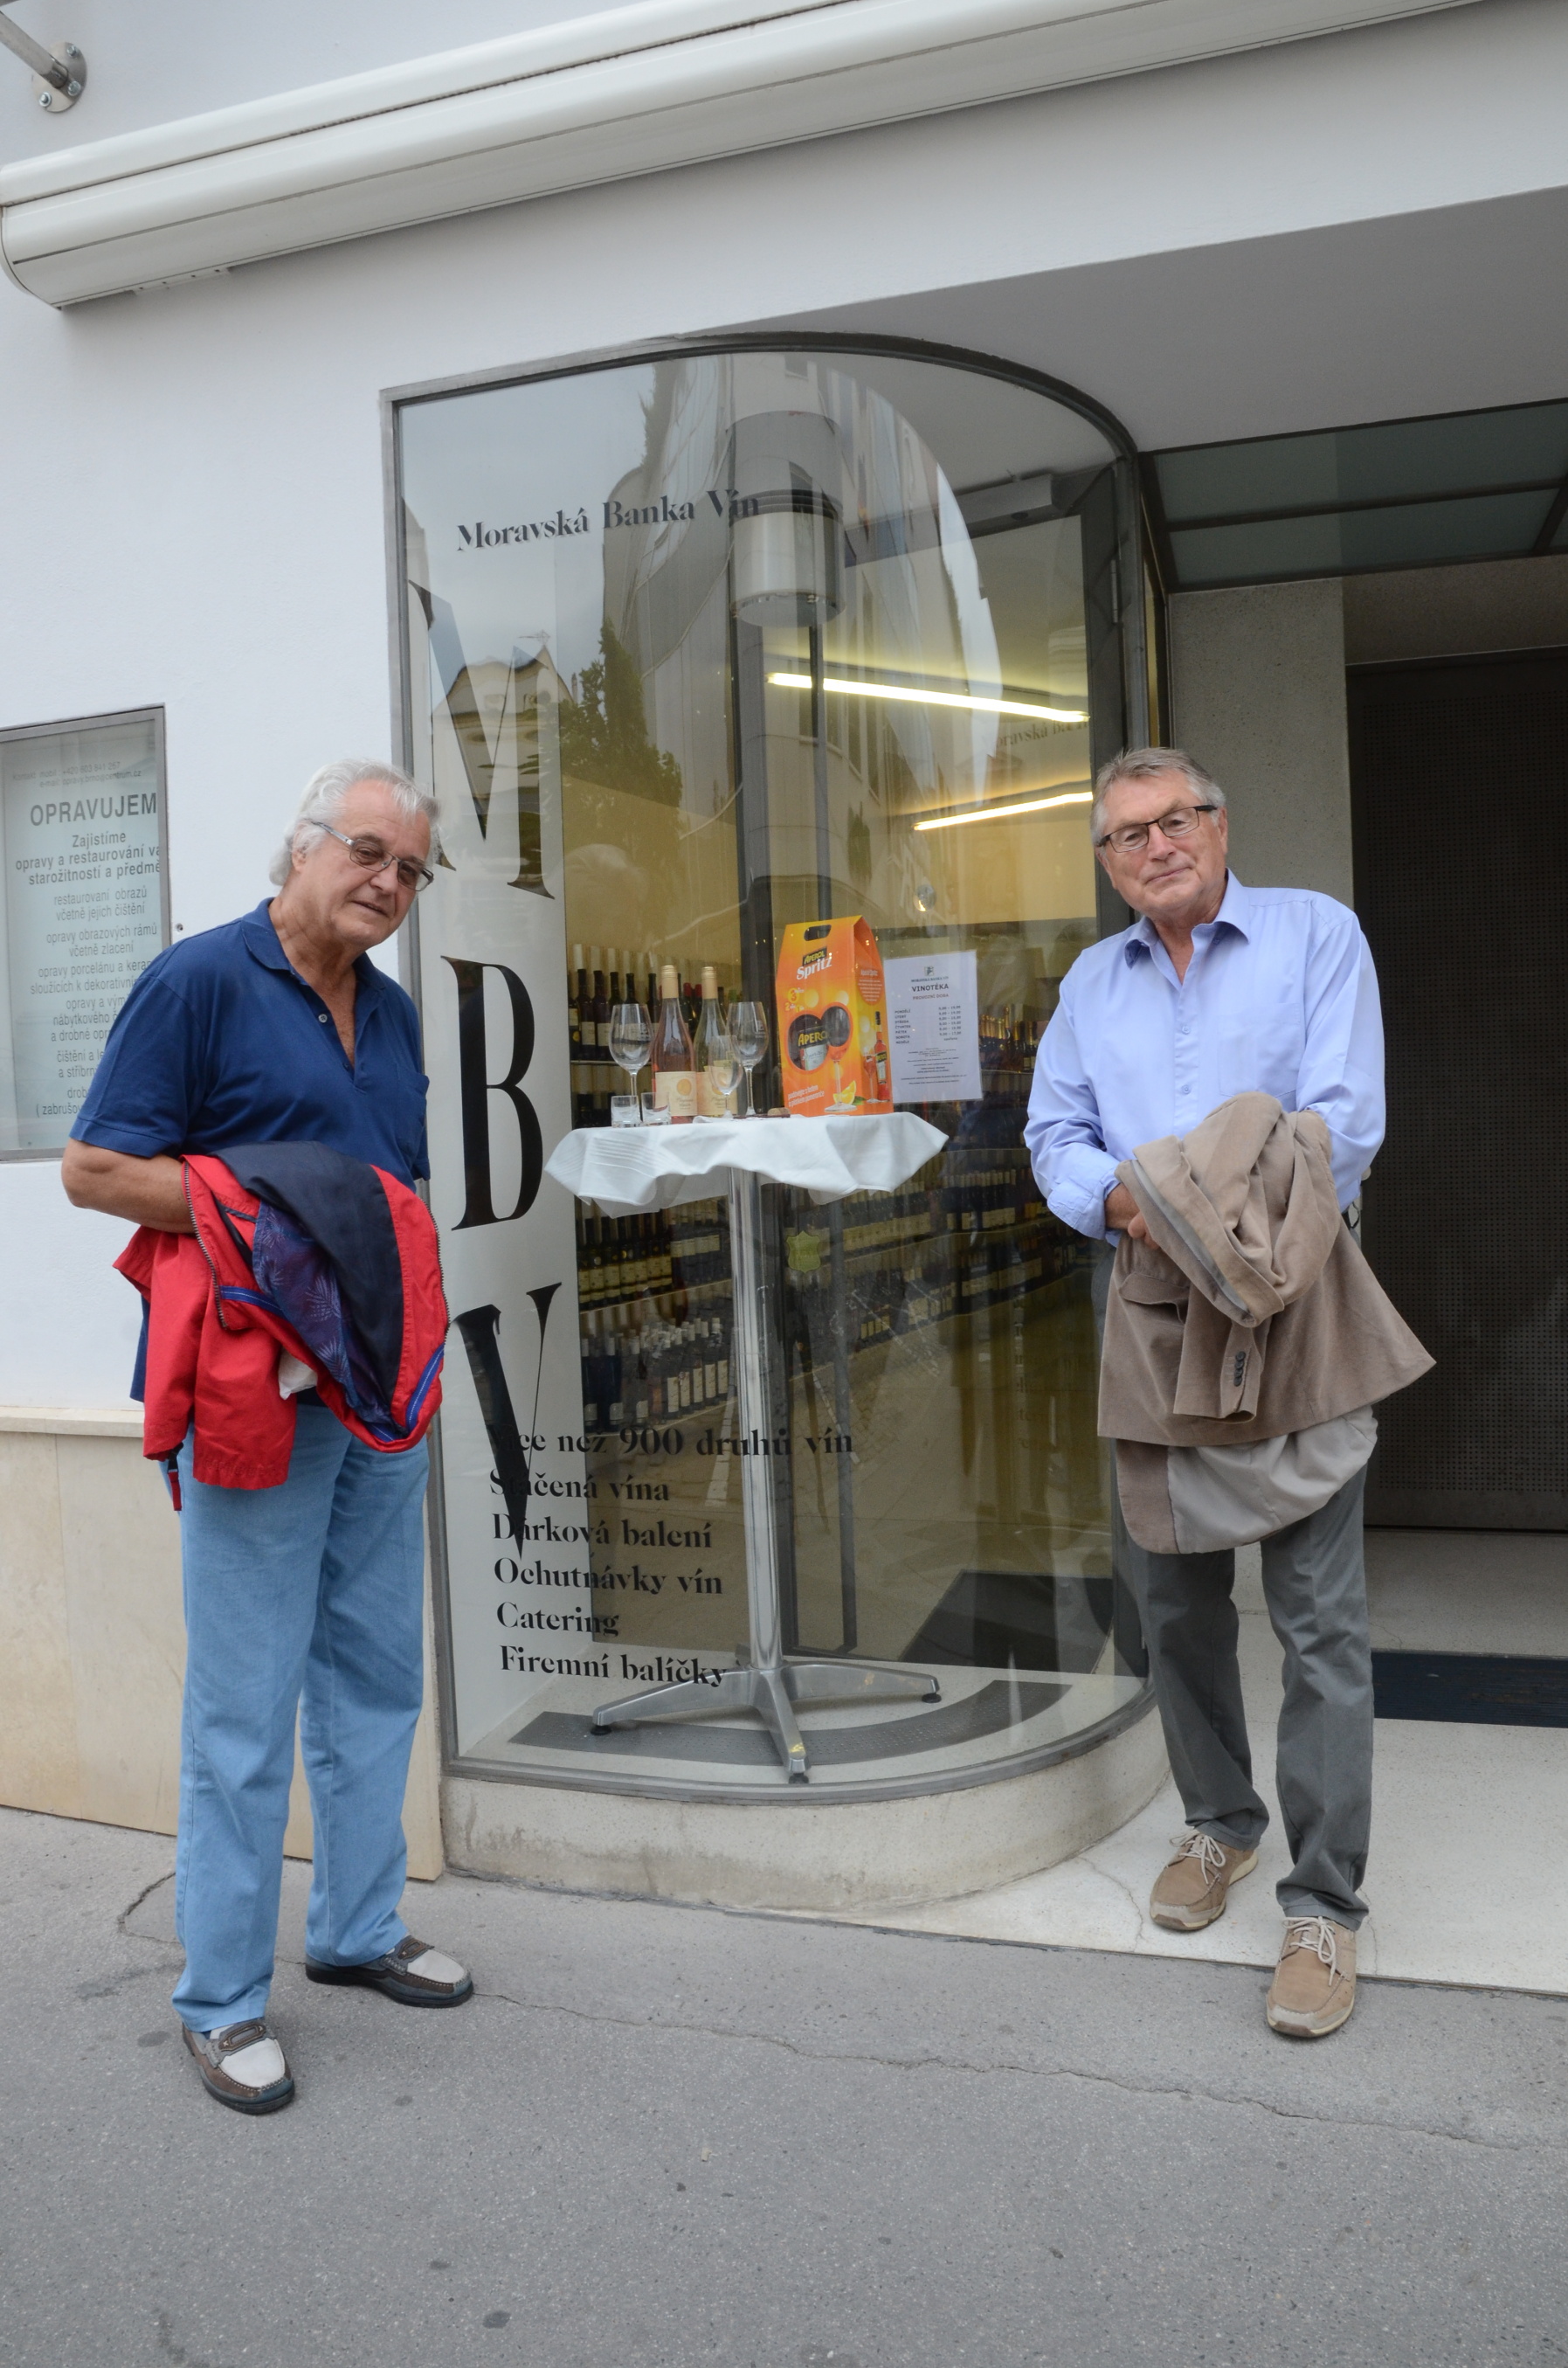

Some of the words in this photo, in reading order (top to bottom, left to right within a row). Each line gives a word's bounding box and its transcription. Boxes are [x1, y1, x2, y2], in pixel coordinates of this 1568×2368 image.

[457, 507, 589, 551] Moravská
[602, 495, 695, 530] Banka
[706, 488, 760, 518] Vín
[30, 792, 157, 827] OPRAVUJEM
[72, 831, 127, 850] Zajistíme
[16, 855, 54, 873] opravy
[58, 855, 65, 867] a
[69, 843, 145, 865] restaurování
[29, 864, 102, 886] starožitností
[105, 867, 113, 878] a
[114, 884, 148, 901] obrazů
[56, 906, 86, 922] včetně
[87, 904, 113, 922] jejich
[114, 901, 146, 917] čištění
[46, 930, 77, 946] opravy
[79, 924, 131, 942] obrazových
[133, 922, 158, 937] rámů
[69, 943, 99, 958] včetně
[101, 940, 135, 956] zlacení
[804, 950, 825, 965] APEROL
[38, 965, 68, 980] opravy
[71, 961, 115, 978] porcelánu
[117, 962, 124, 973] a
[796, 957, 832, 980] Spritz
[76, 980, 82, 992] k
[84, 974, 137, 992] dekorativní
[911, 982, 950, 993] VINOTÉKA
[66, 996, 96, 1012] opravy
[99, 998, 105, 1007] a
[107, 994, 129, 1010] vým
[52, 1011, 110, 1028] nábytkového
[51, 1032, 57, 1042] a
[59, 1028, 91, 1042] drobné
[93, 1029, 110, 1042] opr
[798, 1030, 827, 1047] APERO
[88, 1051, 94, 1062] a
[58, 1068, 65, 1078] a
[66, 1085, 88, 1099] drob
[440, 954, 543, 1231] B
[450, 1282, 563, 1561] V
[556, 1429, 608, 1454] než
[619, 1426, 684, 1456] 900
[805, 1426, 854, 1454] vín
[489, 1468, 598, 1499] Sčená
[608, 1473, 670, 1501] vína
[492, 1513, 610, 1546] Dárková
[621, 1519, 712, 1548] balení
[494, 1556, 667, 1596] Ochutnávky
[677, 1568, 723, 1595] vín
[496, 1601, 620, 1638] Catering
[500, 1644, 611, 1679] Firemní
[620, 1653, 727, 1688] balíčky
